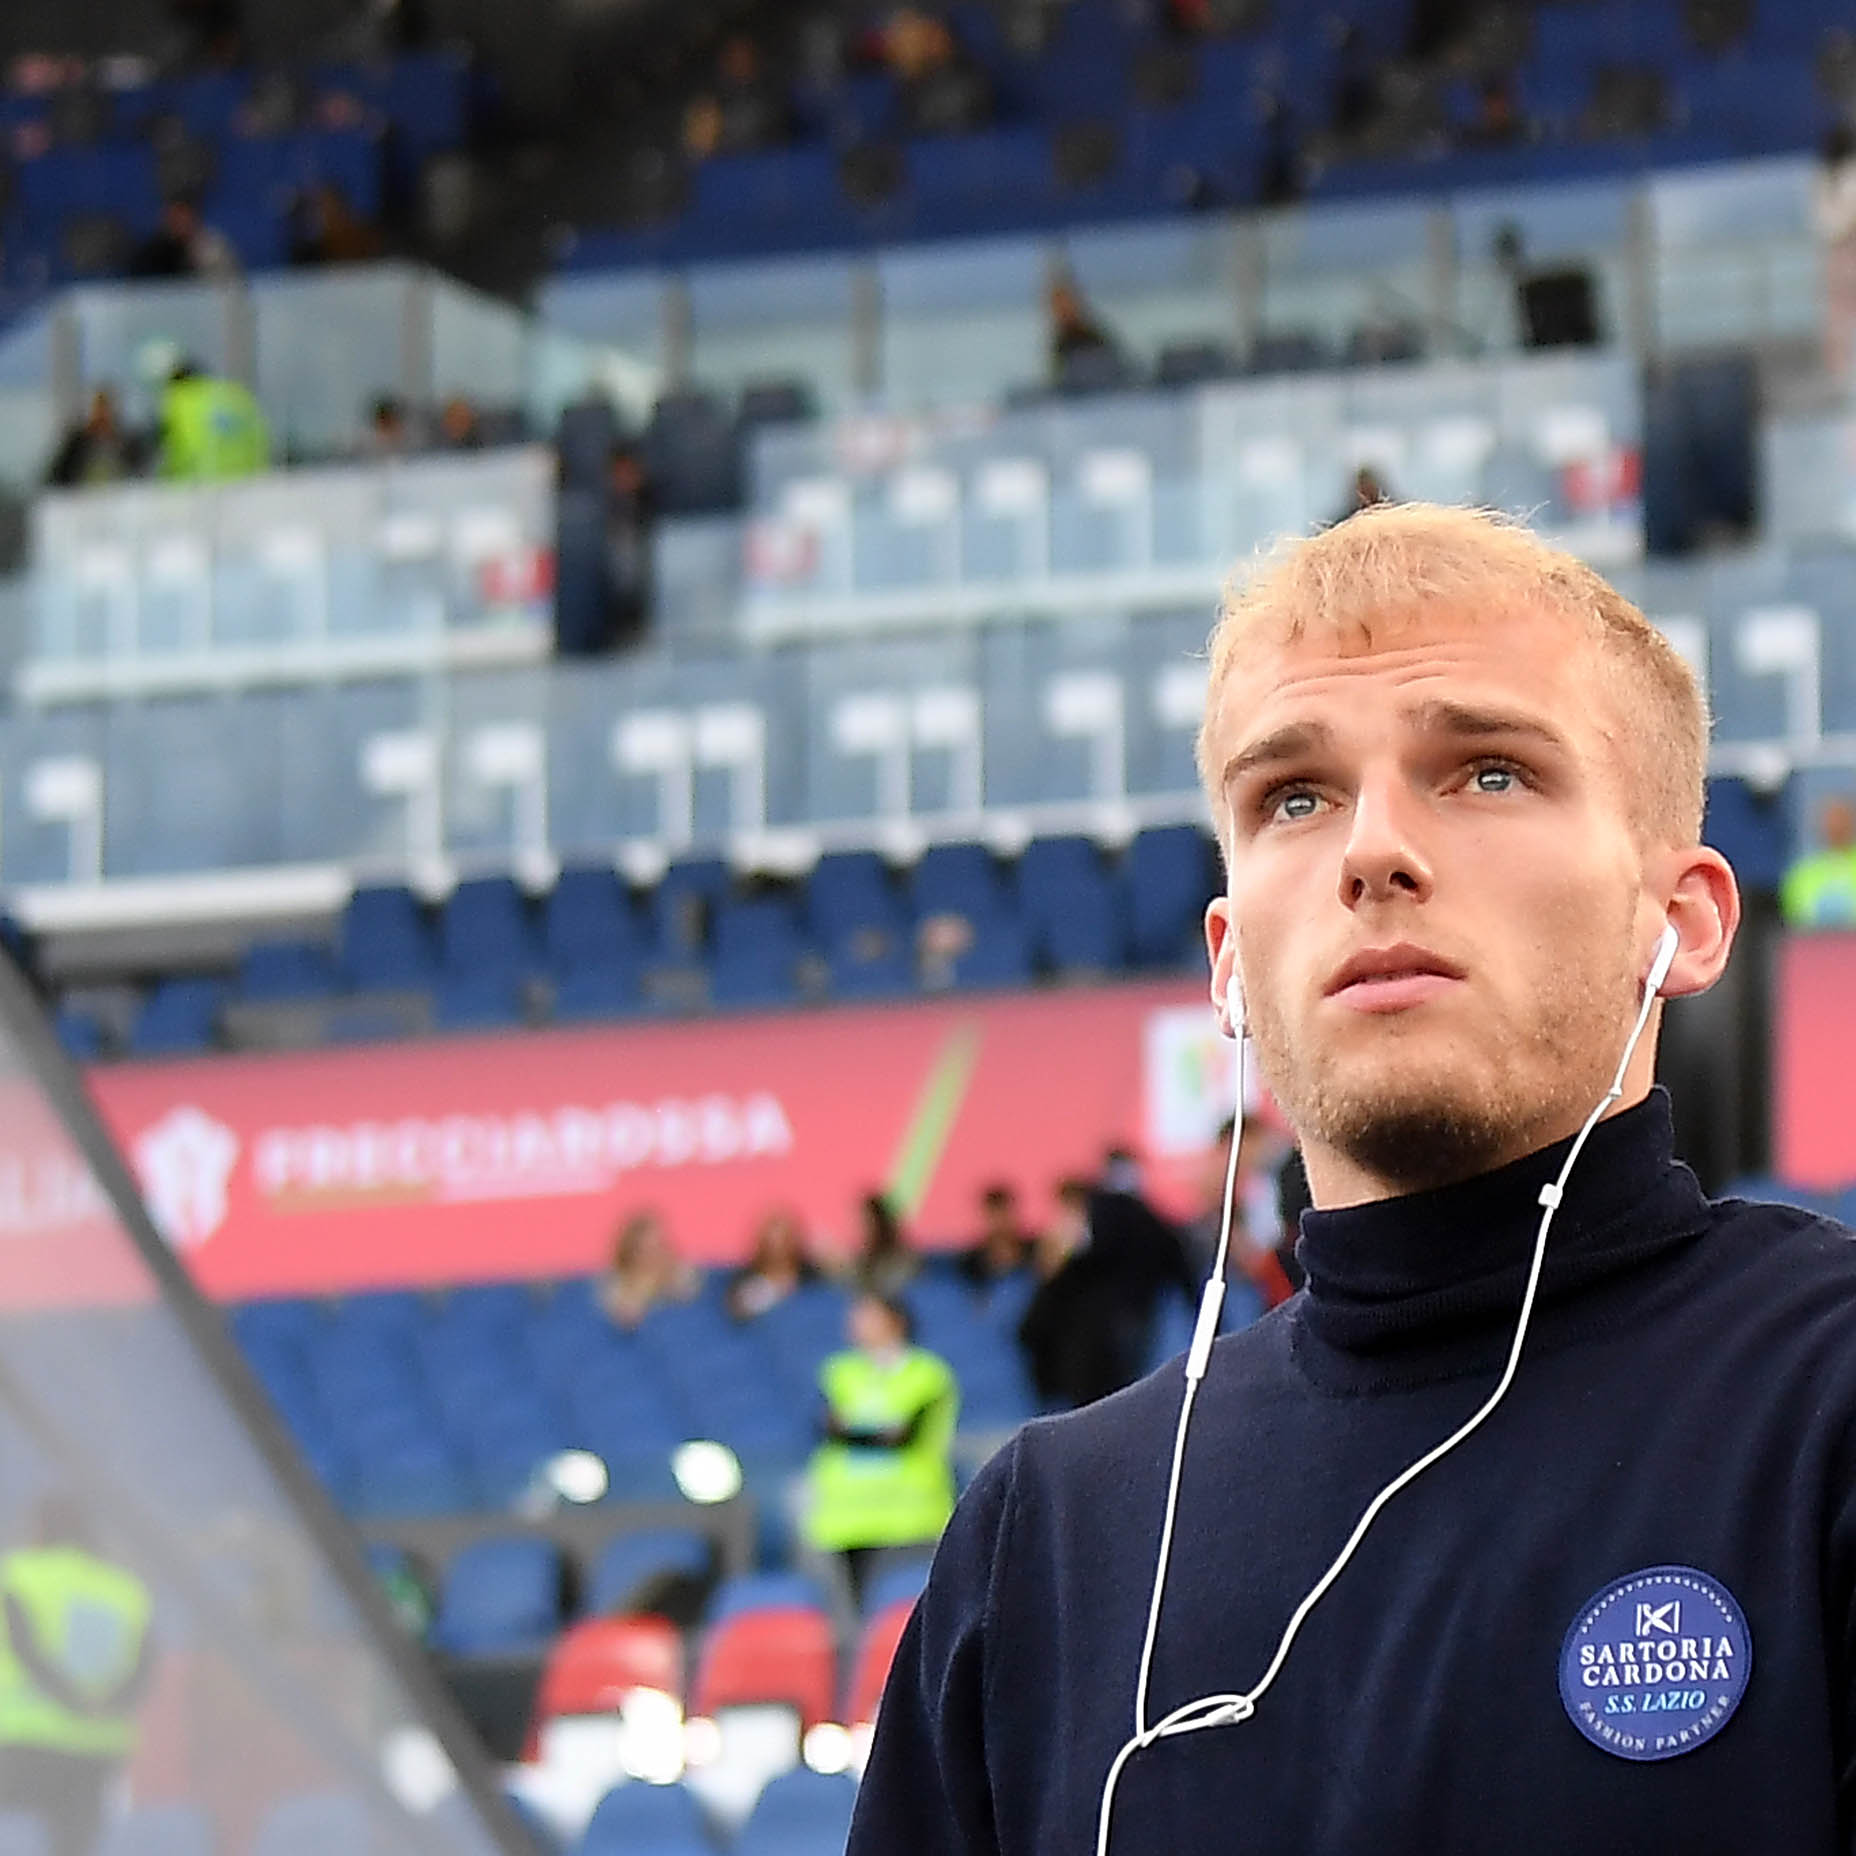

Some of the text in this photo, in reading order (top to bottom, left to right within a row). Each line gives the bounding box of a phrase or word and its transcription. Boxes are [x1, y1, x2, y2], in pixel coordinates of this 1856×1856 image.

[256, 1092, 792, 1186] FRECCIAROSSA
[1579, 1636, 1734, 1666] SARTORIA
[1582, 1659, 1730, 1687] CARDONA
[1604, 1690, 1706, 1714] S.S. LAZIO
[1579, 1695, 1729, 1750] FASHION PARTNER
